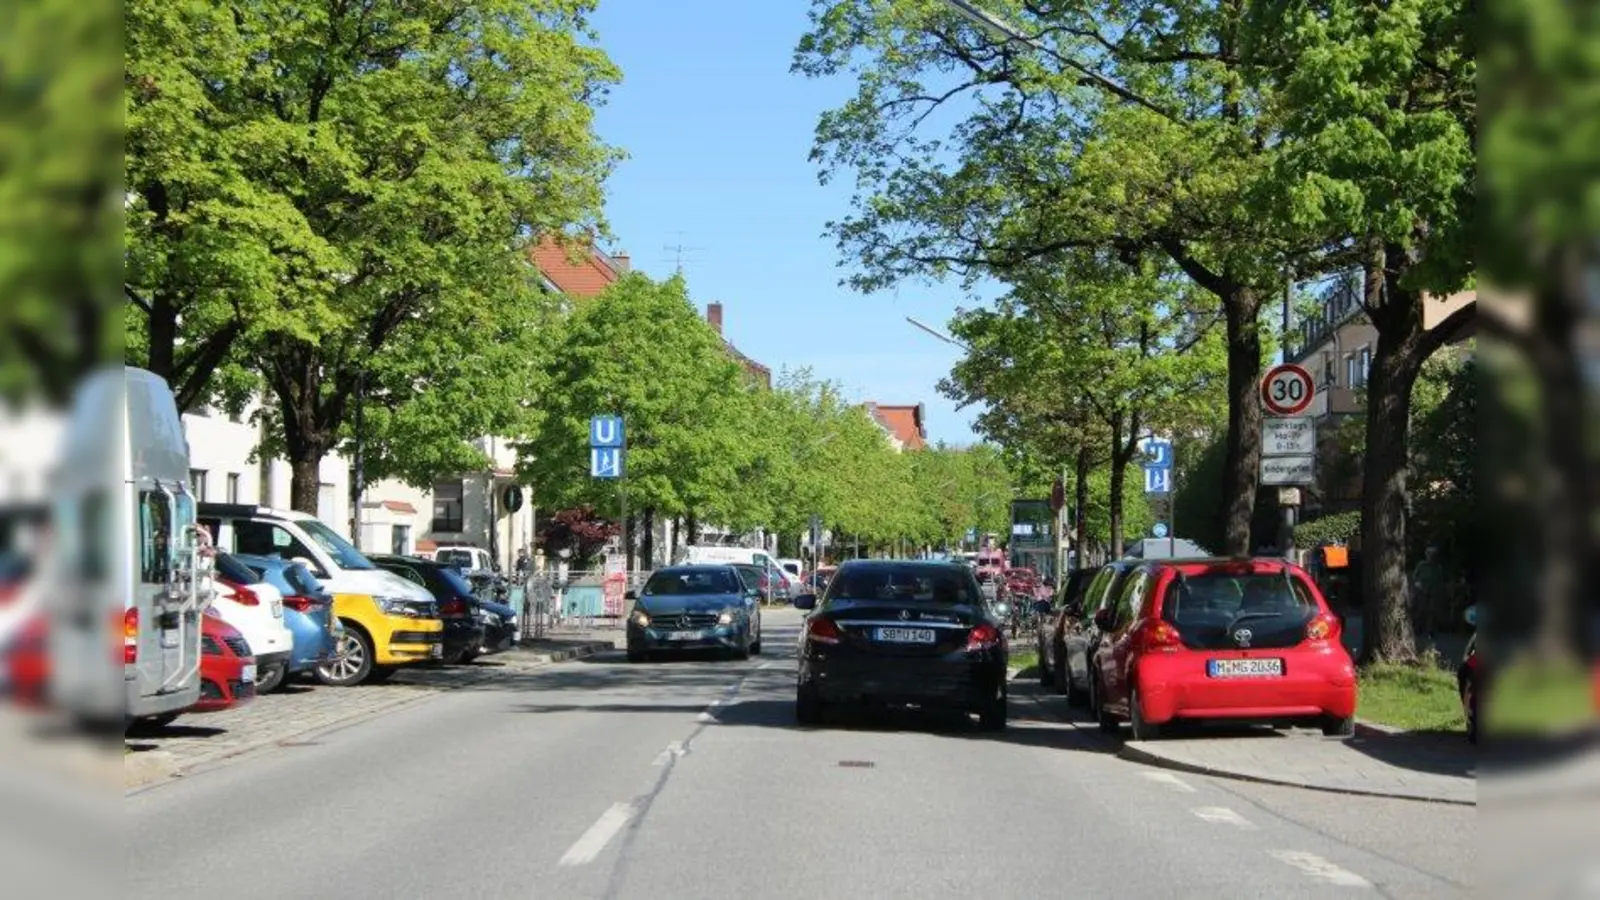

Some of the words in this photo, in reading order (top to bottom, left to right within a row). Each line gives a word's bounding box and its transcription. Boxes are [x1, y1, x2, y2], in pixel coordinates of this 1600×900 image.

[1273, 379, 1303, 402] 30
[596, 419, 615, 443] U
[1217, 661, 1226, 673] M
[1232, 661, 1248, 673] MG
[1250, 661, 1280, 673] 2036
